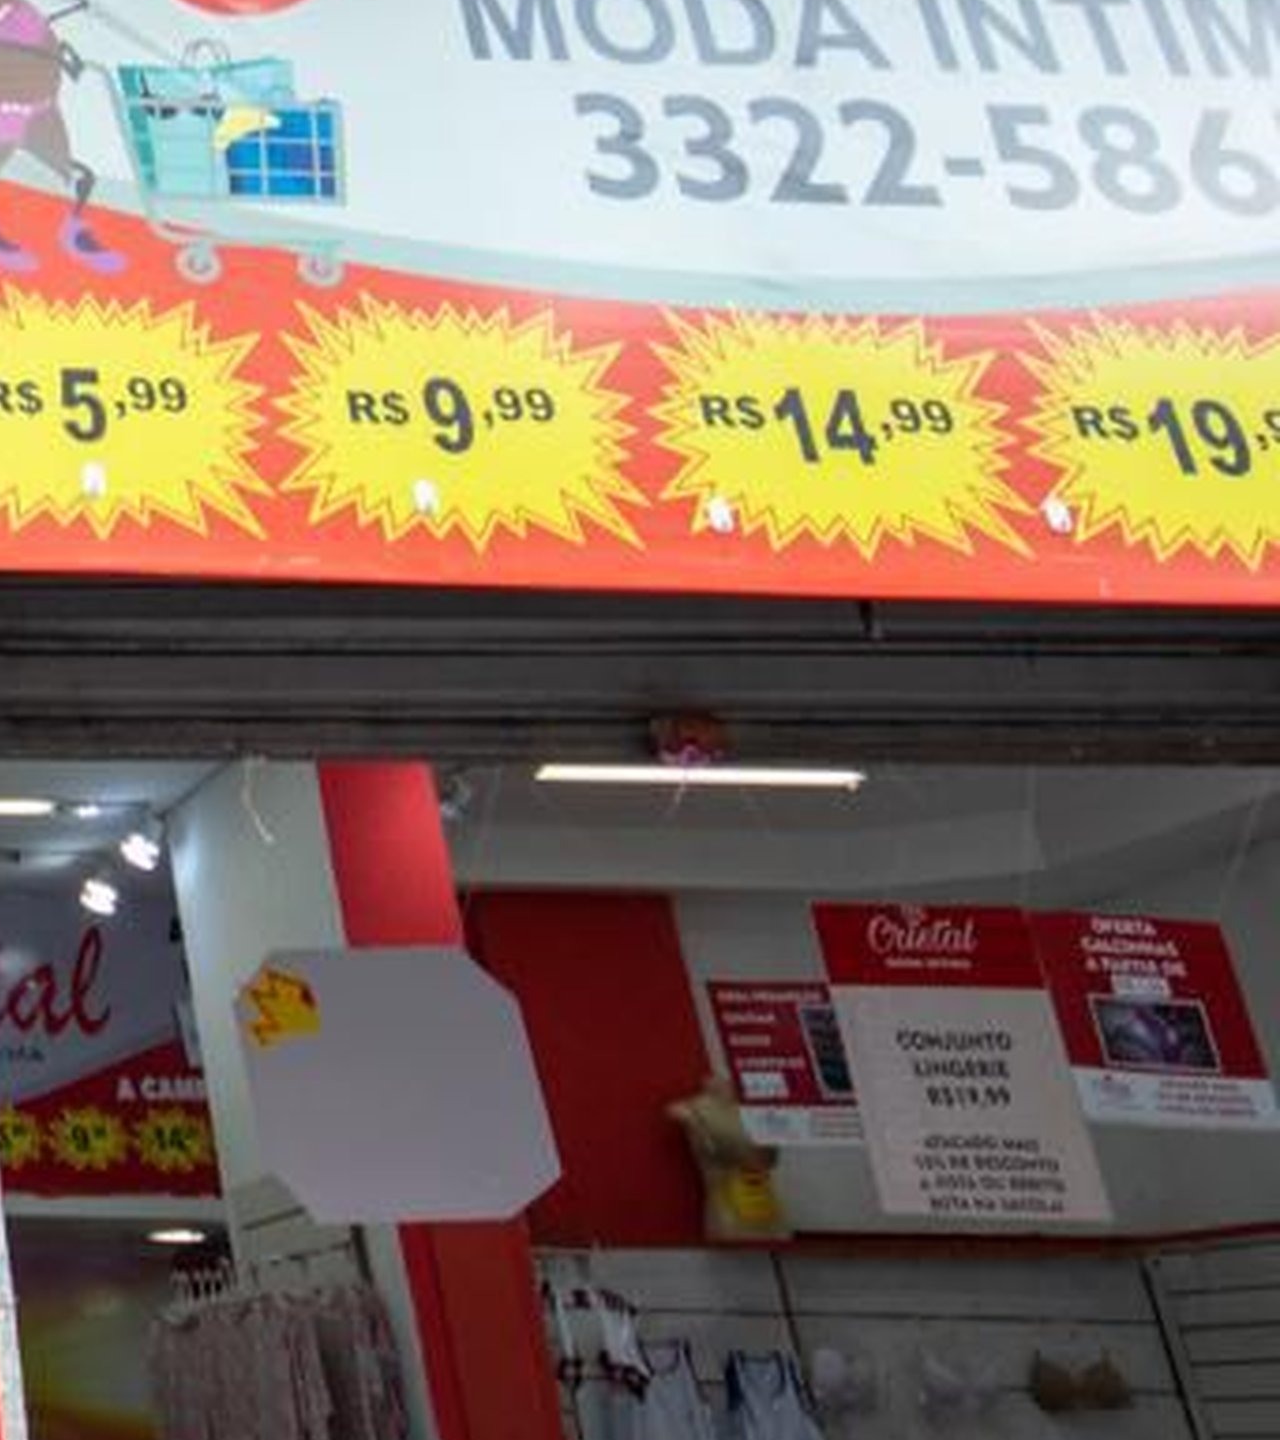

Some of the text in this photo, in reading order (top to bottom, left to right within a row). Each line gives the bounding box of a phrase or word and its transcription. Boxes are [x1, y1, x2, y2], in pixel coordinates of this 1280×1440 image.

[573, 91, 1280, 216] 3322-586
[58, 366, 189, 444] 5,99
[345, 375, 556, 455] R$ 9,99
[773, 386, 955, 466] 14,99
